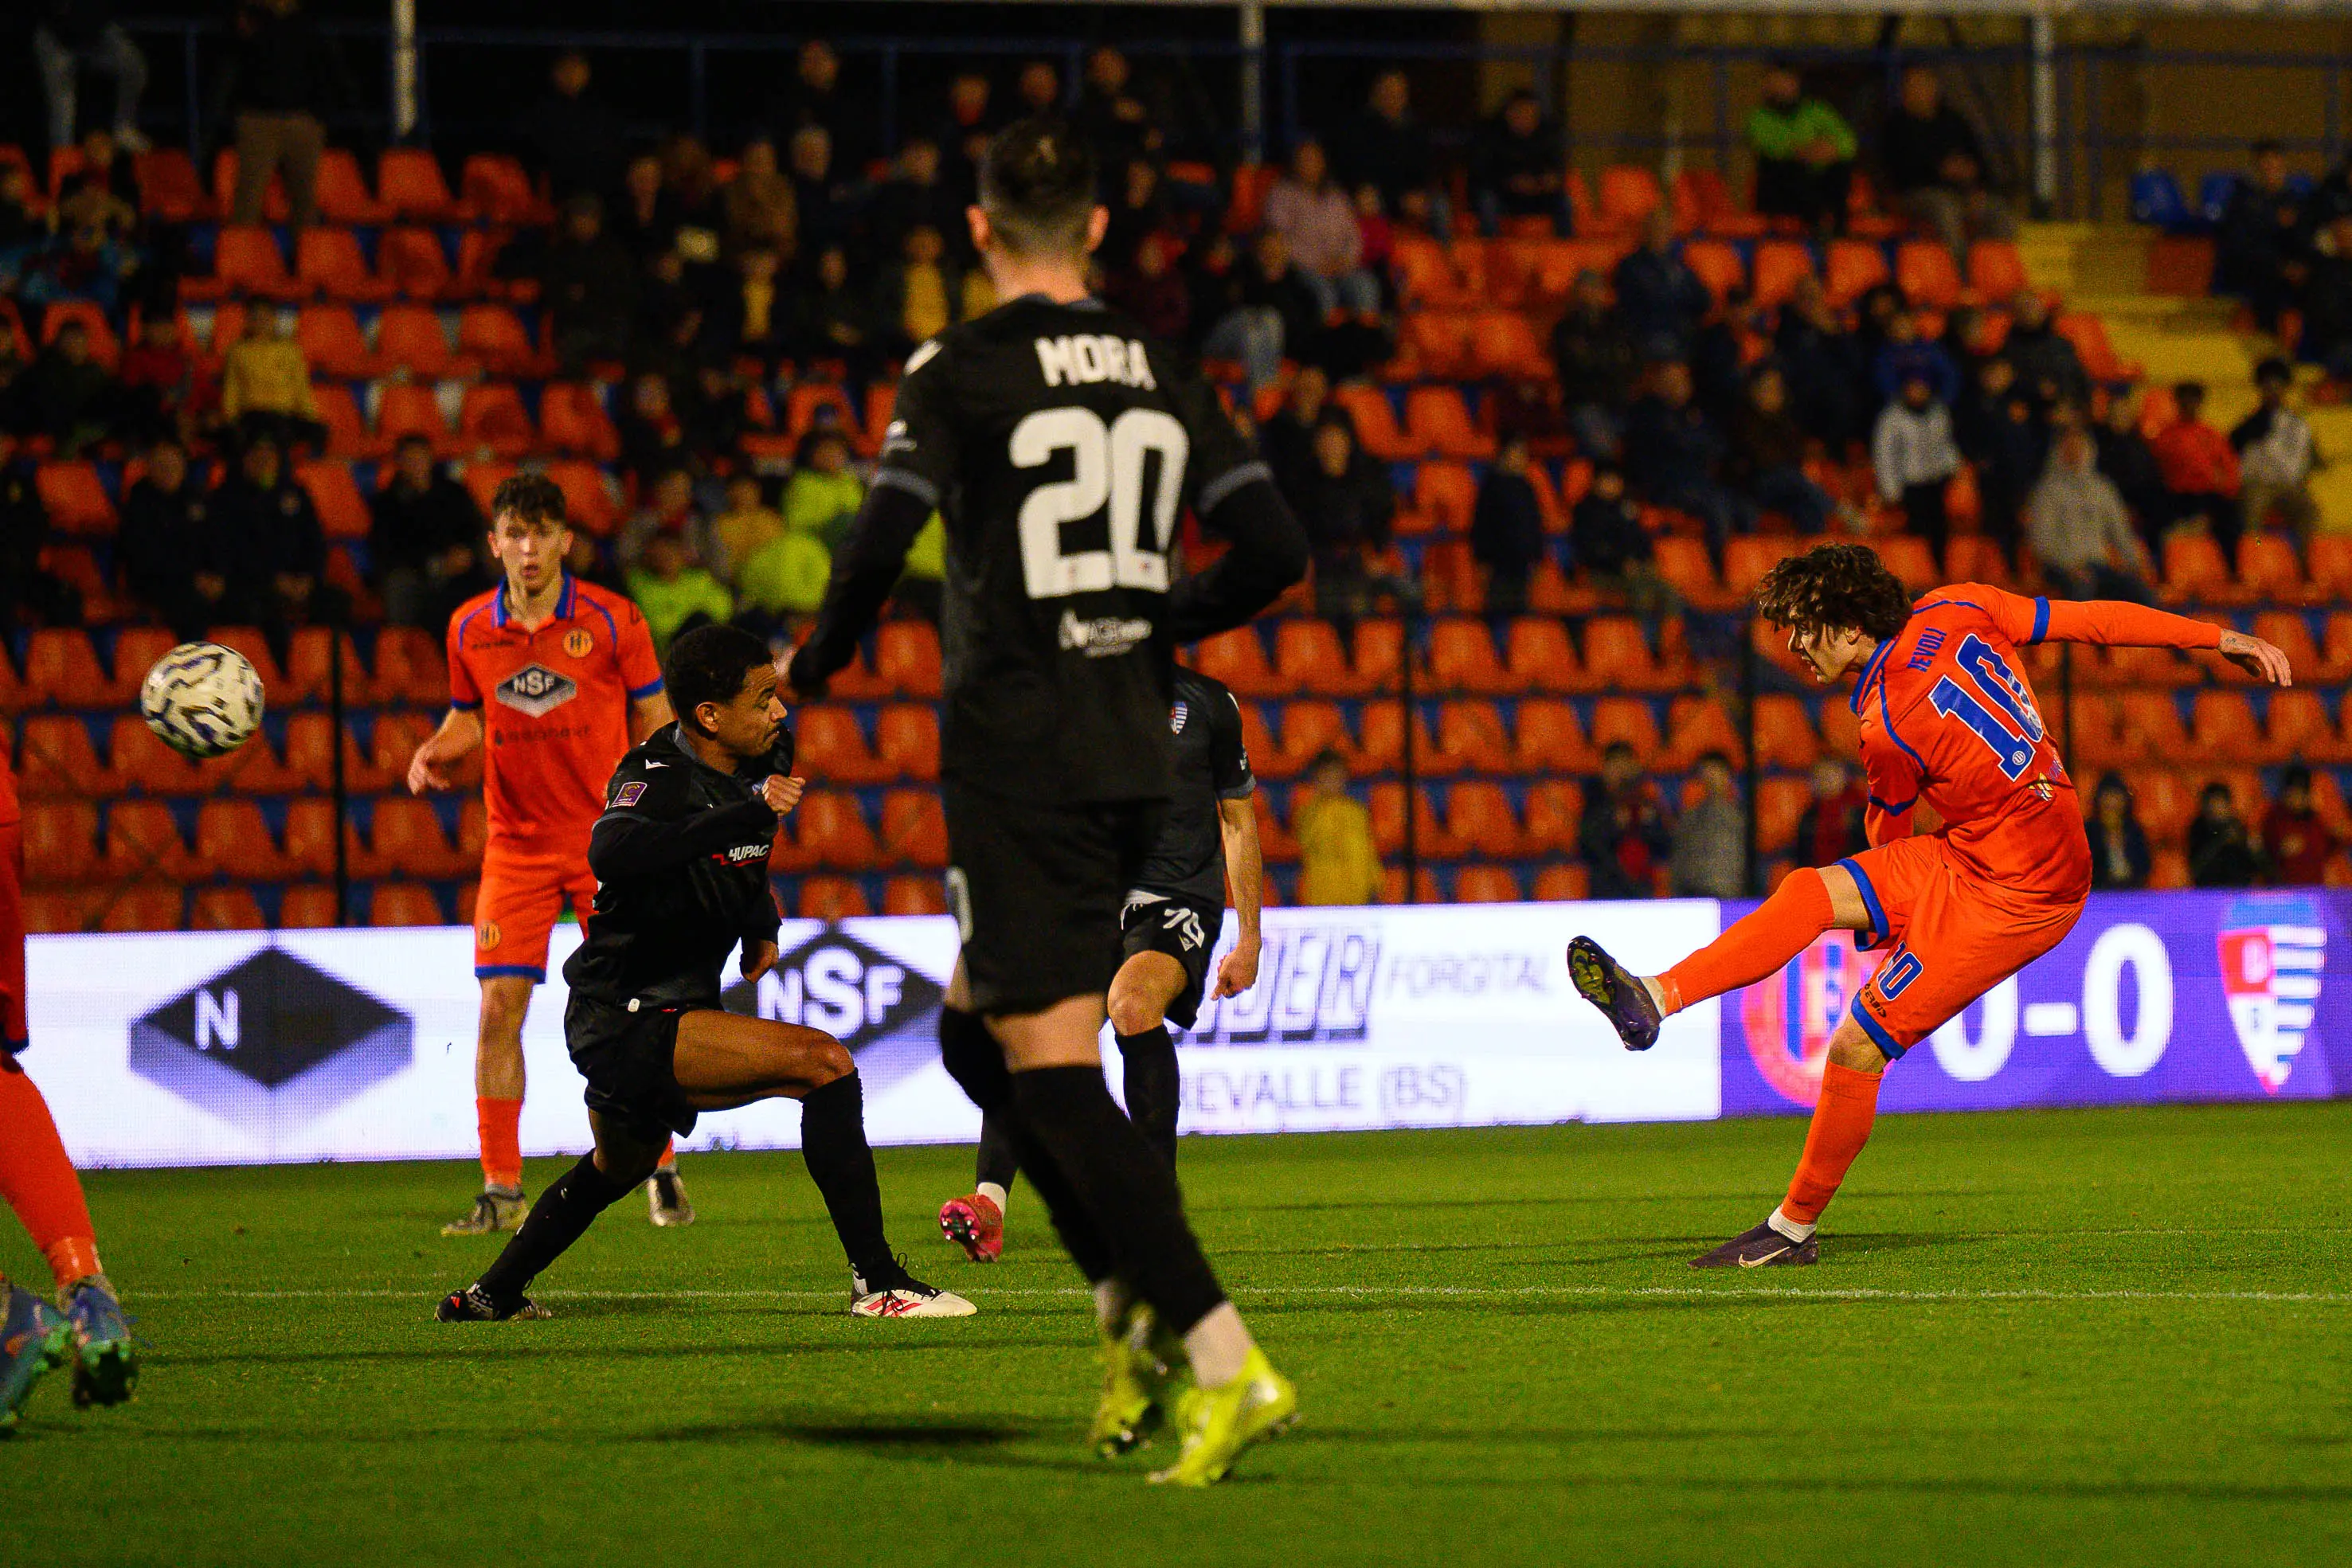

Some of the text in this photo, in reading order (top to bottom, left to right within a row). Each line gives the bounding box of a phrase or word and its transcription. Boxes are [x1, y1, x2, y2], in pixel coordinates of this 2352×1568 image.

[1035, 333, 1157, 391] MORA
[1008, 405, 1190, 600] 20
[513, 670, 555, 696] NSF
[1927, 632, 2045, 783] 10
[194, 985, 240, 1050] N
[757, 945, 905, 1039] NSF
[1181, 1065, 1360, 1114] EVALLE
